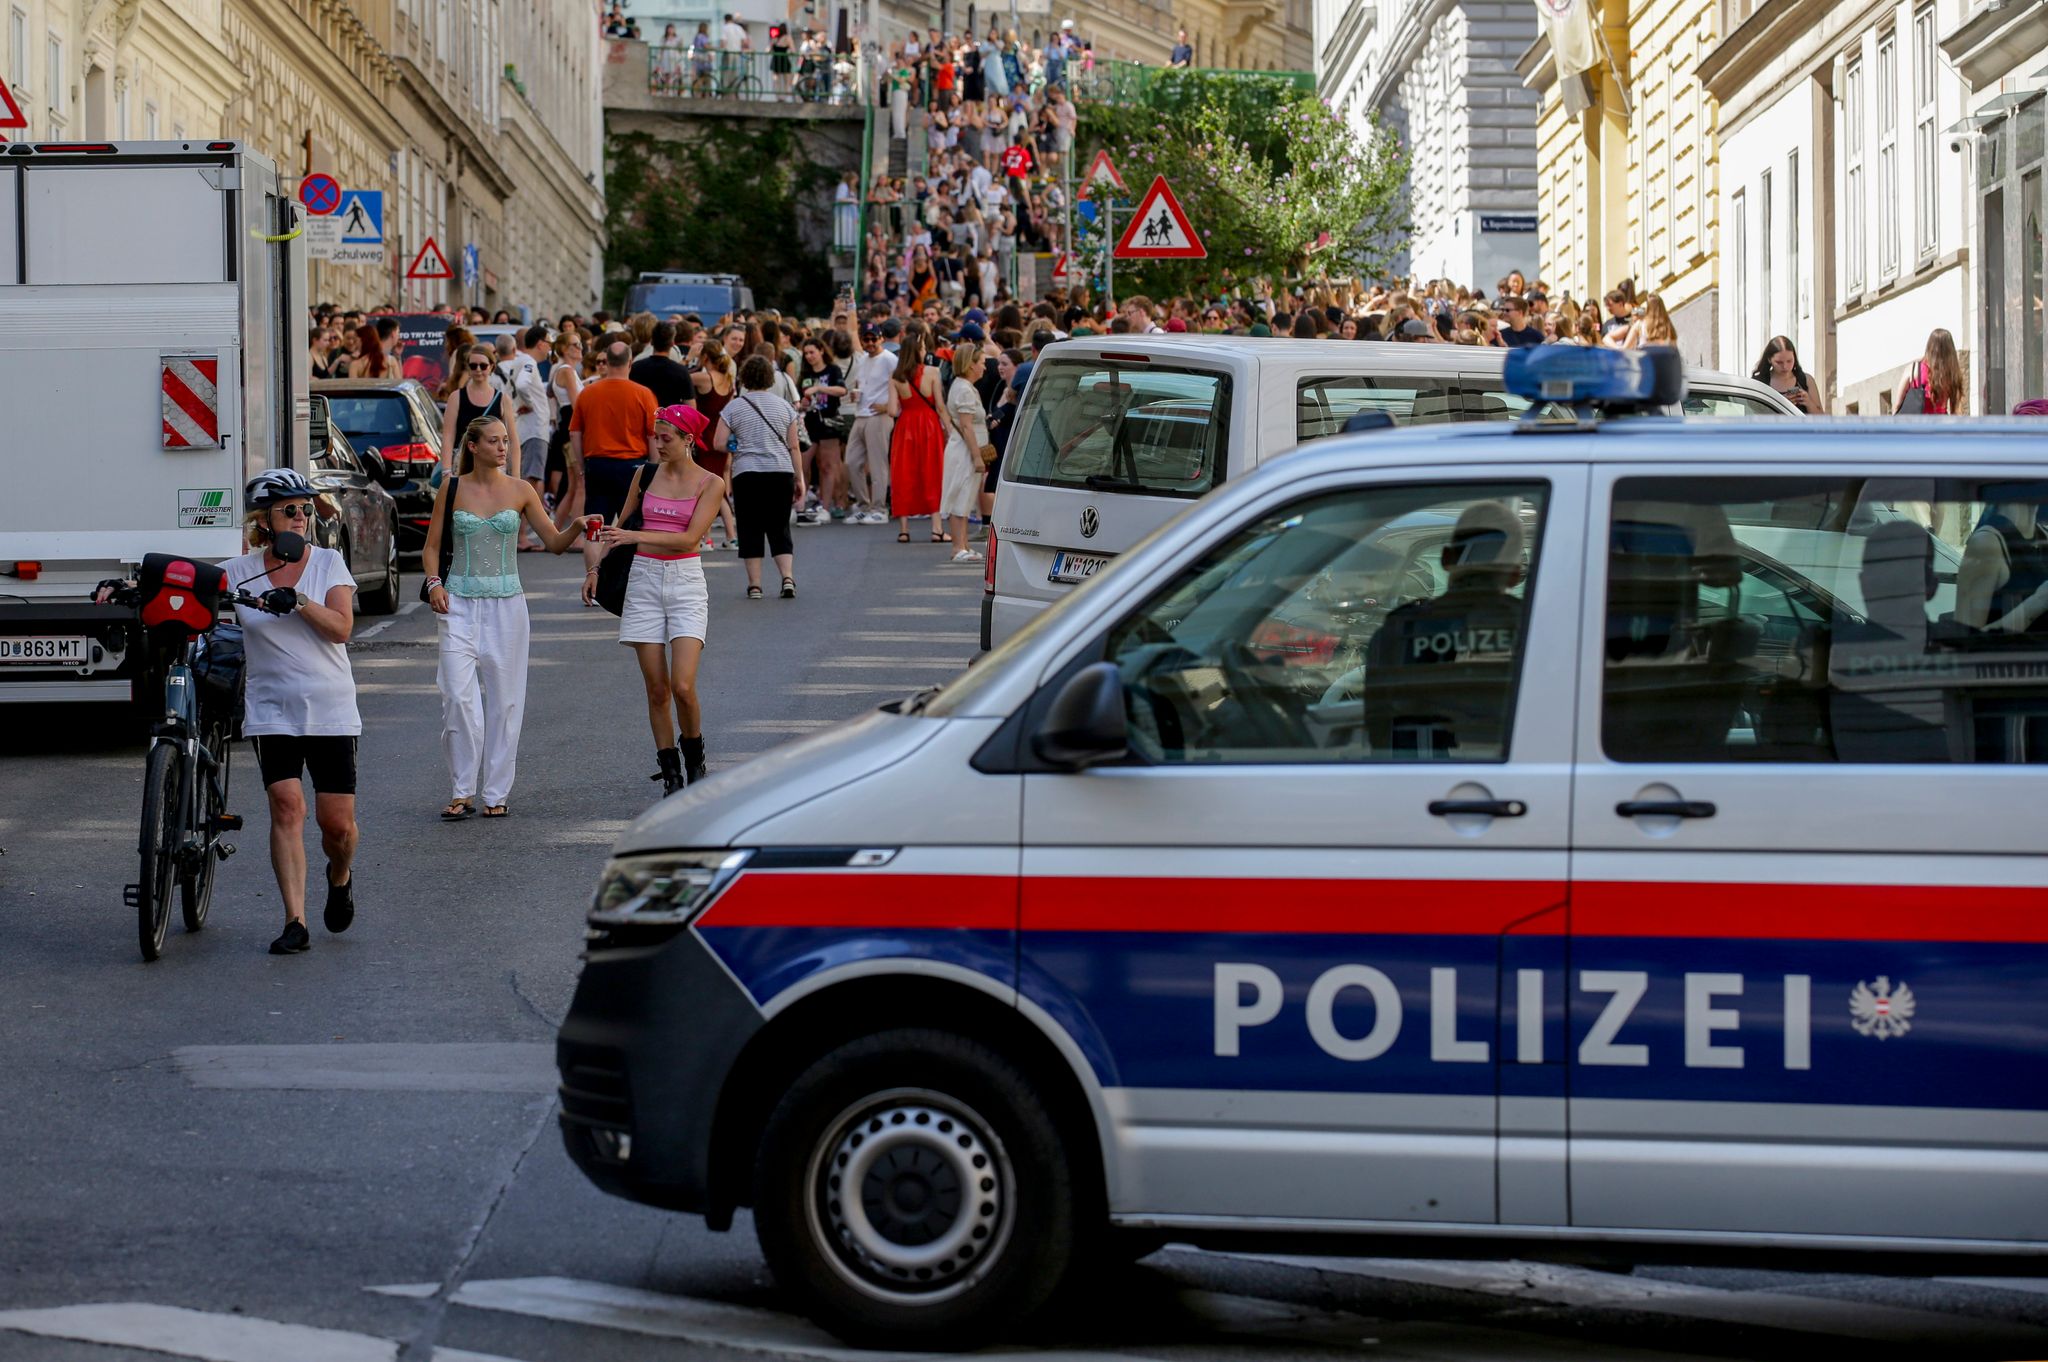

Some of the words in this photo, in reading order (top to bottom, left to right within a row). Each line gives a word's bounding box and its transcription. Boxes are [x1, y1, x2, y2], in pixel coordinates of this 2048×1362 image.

[411, 331, 426, 339] TRY
[24, 640, 54, 657] 863
[59, 640, 80, 657] MT
[1213, 962, 1812, 1070] POLIZEI
